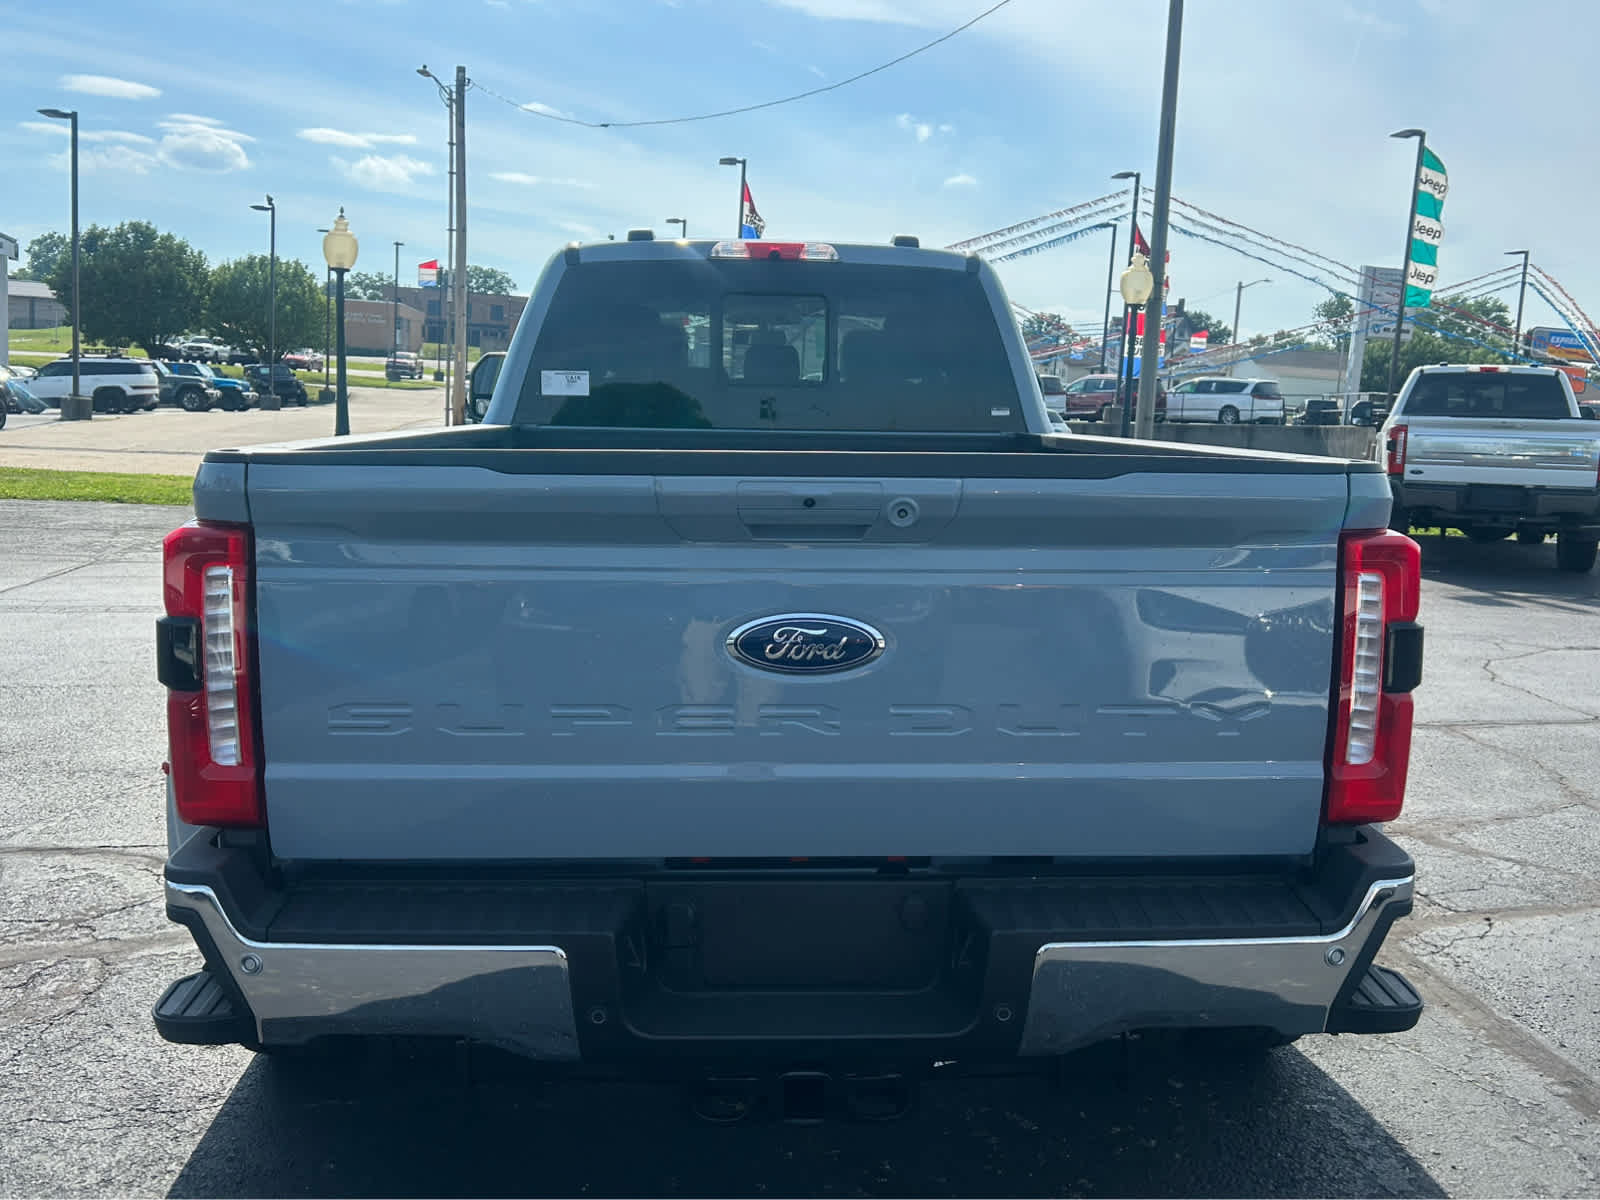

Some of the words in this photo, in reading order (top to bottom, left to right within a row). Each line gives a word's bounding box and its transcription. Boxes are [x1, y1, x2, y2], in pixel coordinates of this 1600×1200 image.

[1420, 173, 1447, 195] Jeep
[1414, 220, 1441, 240] Jeep
[1409, 269, 1435, 285] Jeep
[765, 626, 848, 660] Ford
[327, 703, 840, 736] SUPER
[889, 703, 1271, 737] DUTY
